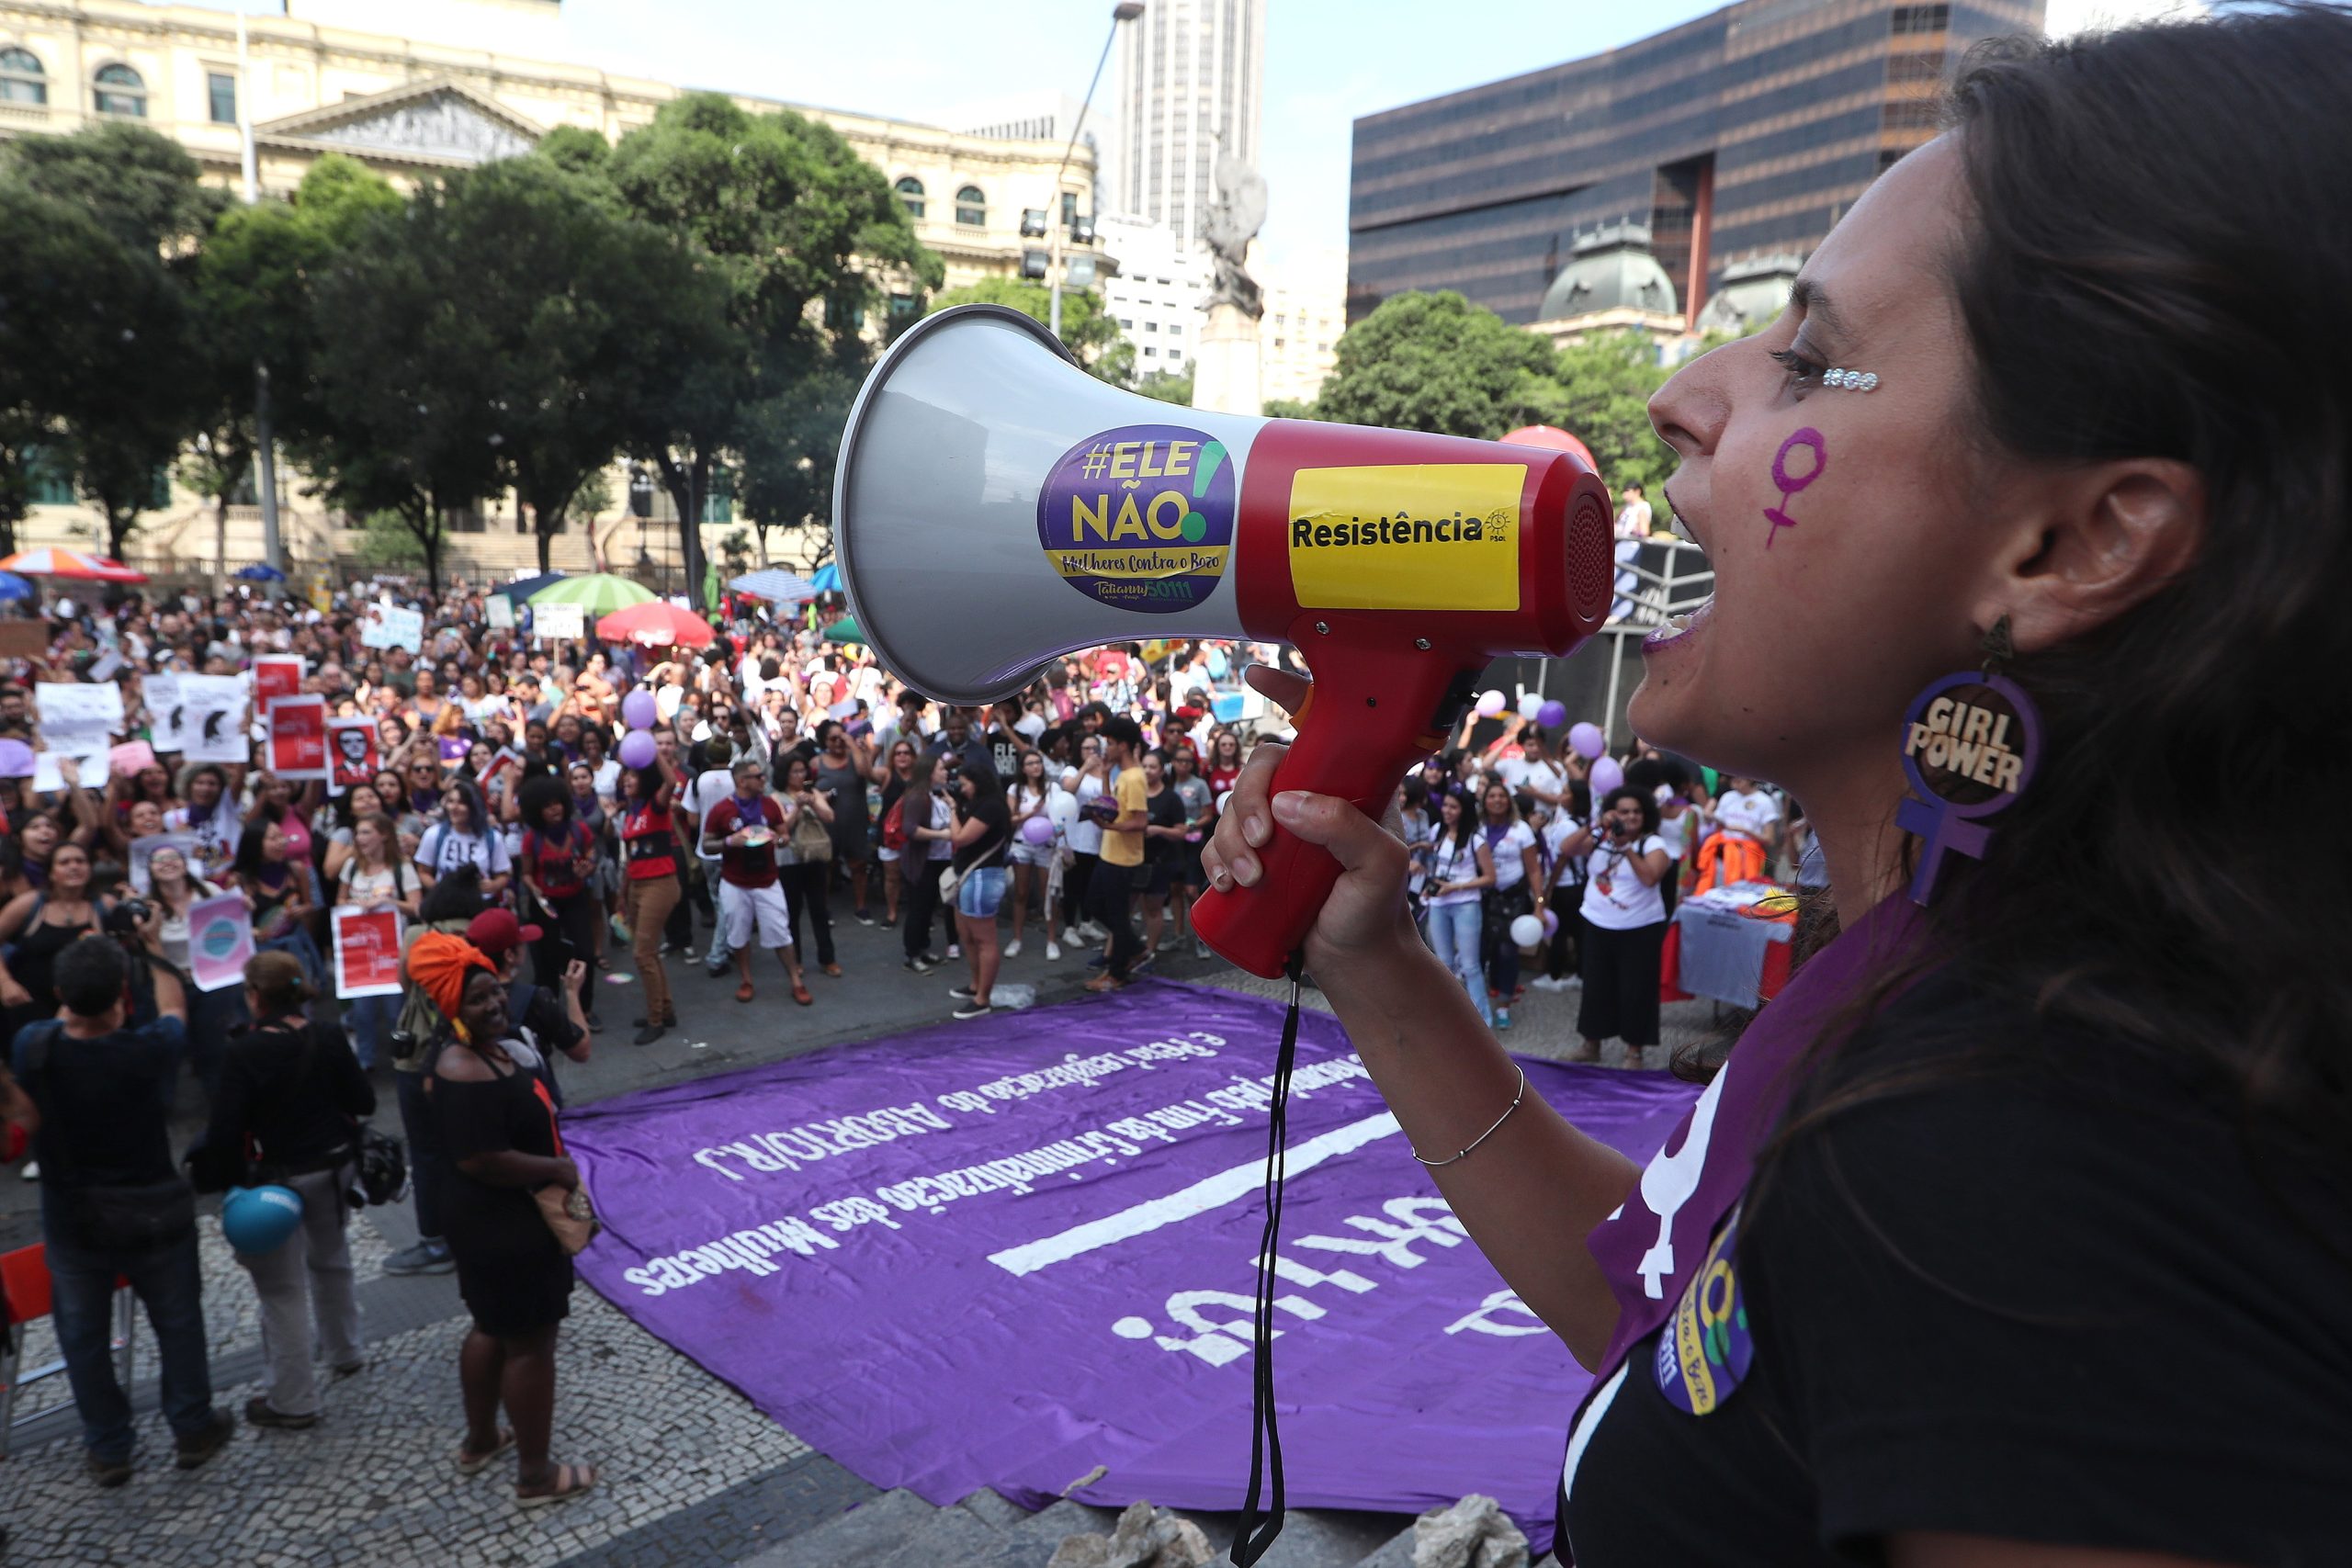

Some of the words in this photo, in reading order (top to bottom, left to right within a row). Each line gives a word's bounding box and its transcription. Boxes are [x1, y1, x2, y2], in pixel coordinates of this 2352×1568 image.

[1082, 441, 1198, 479] #ELE
[1293, 511, 1483, 547] Resistência
[1062, 553, 1125, 572] Mulheres
[1128, 551, 1178, 572] Contra
[1180, 558, 1187, 569] o
[1191, 552, 1219, 570] Bozo
[1093, 581, 1148, 597] Tatianny
[1144, 580, 1193, 599] 50111
[1927, 696, 2011, 751] GIRL
[1905, 722, 2024, 794] POWER
[937, 1089, 997, 1114] do
[1106, 1115, 1177, 1144] da
[809, 1196, 902, 1232] das
[623, 1215, 841, 1296] Mulheres
